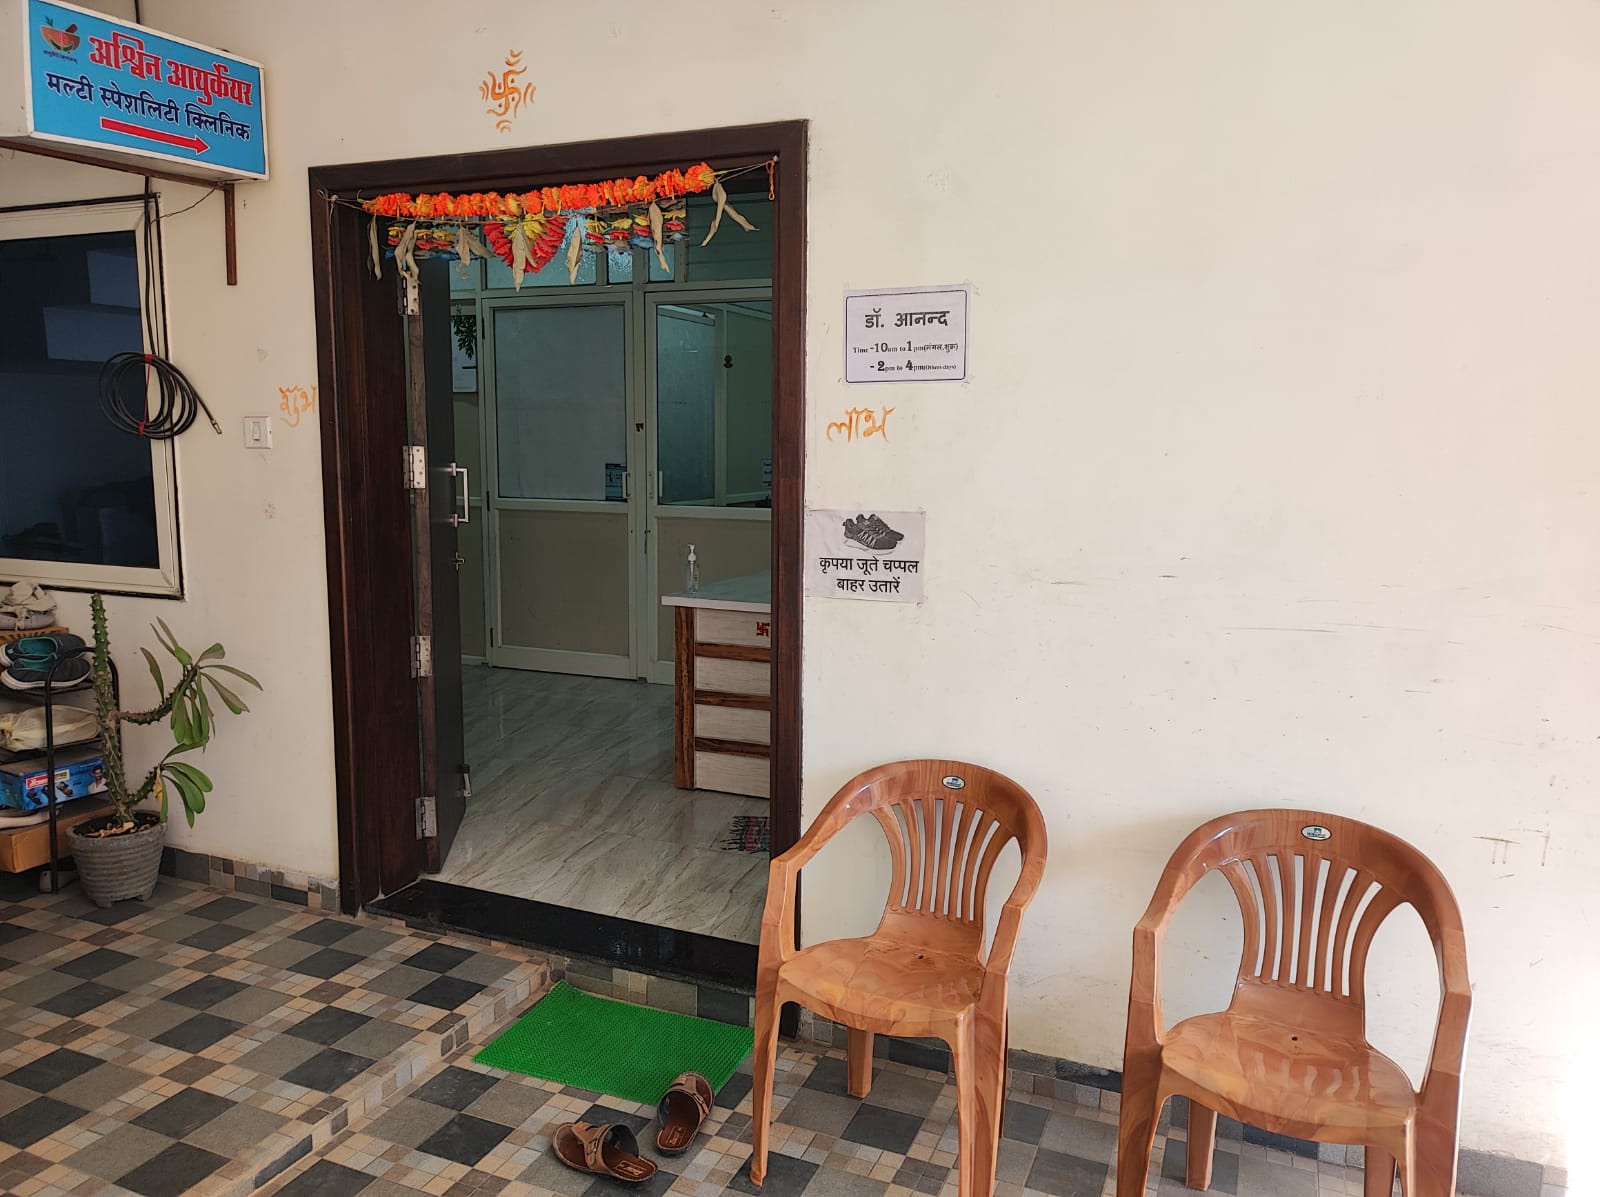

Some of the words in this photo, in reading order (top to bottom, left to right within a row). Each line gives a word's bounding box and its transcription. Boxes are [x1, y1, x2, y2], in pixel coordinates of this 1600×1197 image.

[88, 31, 162, 82] अश्विन
[46, 72, 94, 103] मल्टी
[99, 81, 180, 125] स्पेशलिटी
[184, 103, 251, 141] क्लिनिक
[865, 308, 885, 329] डॉ.
[894, 310, 950, 328] आनन्द
[826, 405, 896, 443] लाभ
[819, 556, 854, 574] कृपया
[856, 555, 879, 576] जूते
[882, 559, 920, 574] चप्पल
[836, 577, 866, 592] बाहर
[868, 576, 901, 594] उतारें
